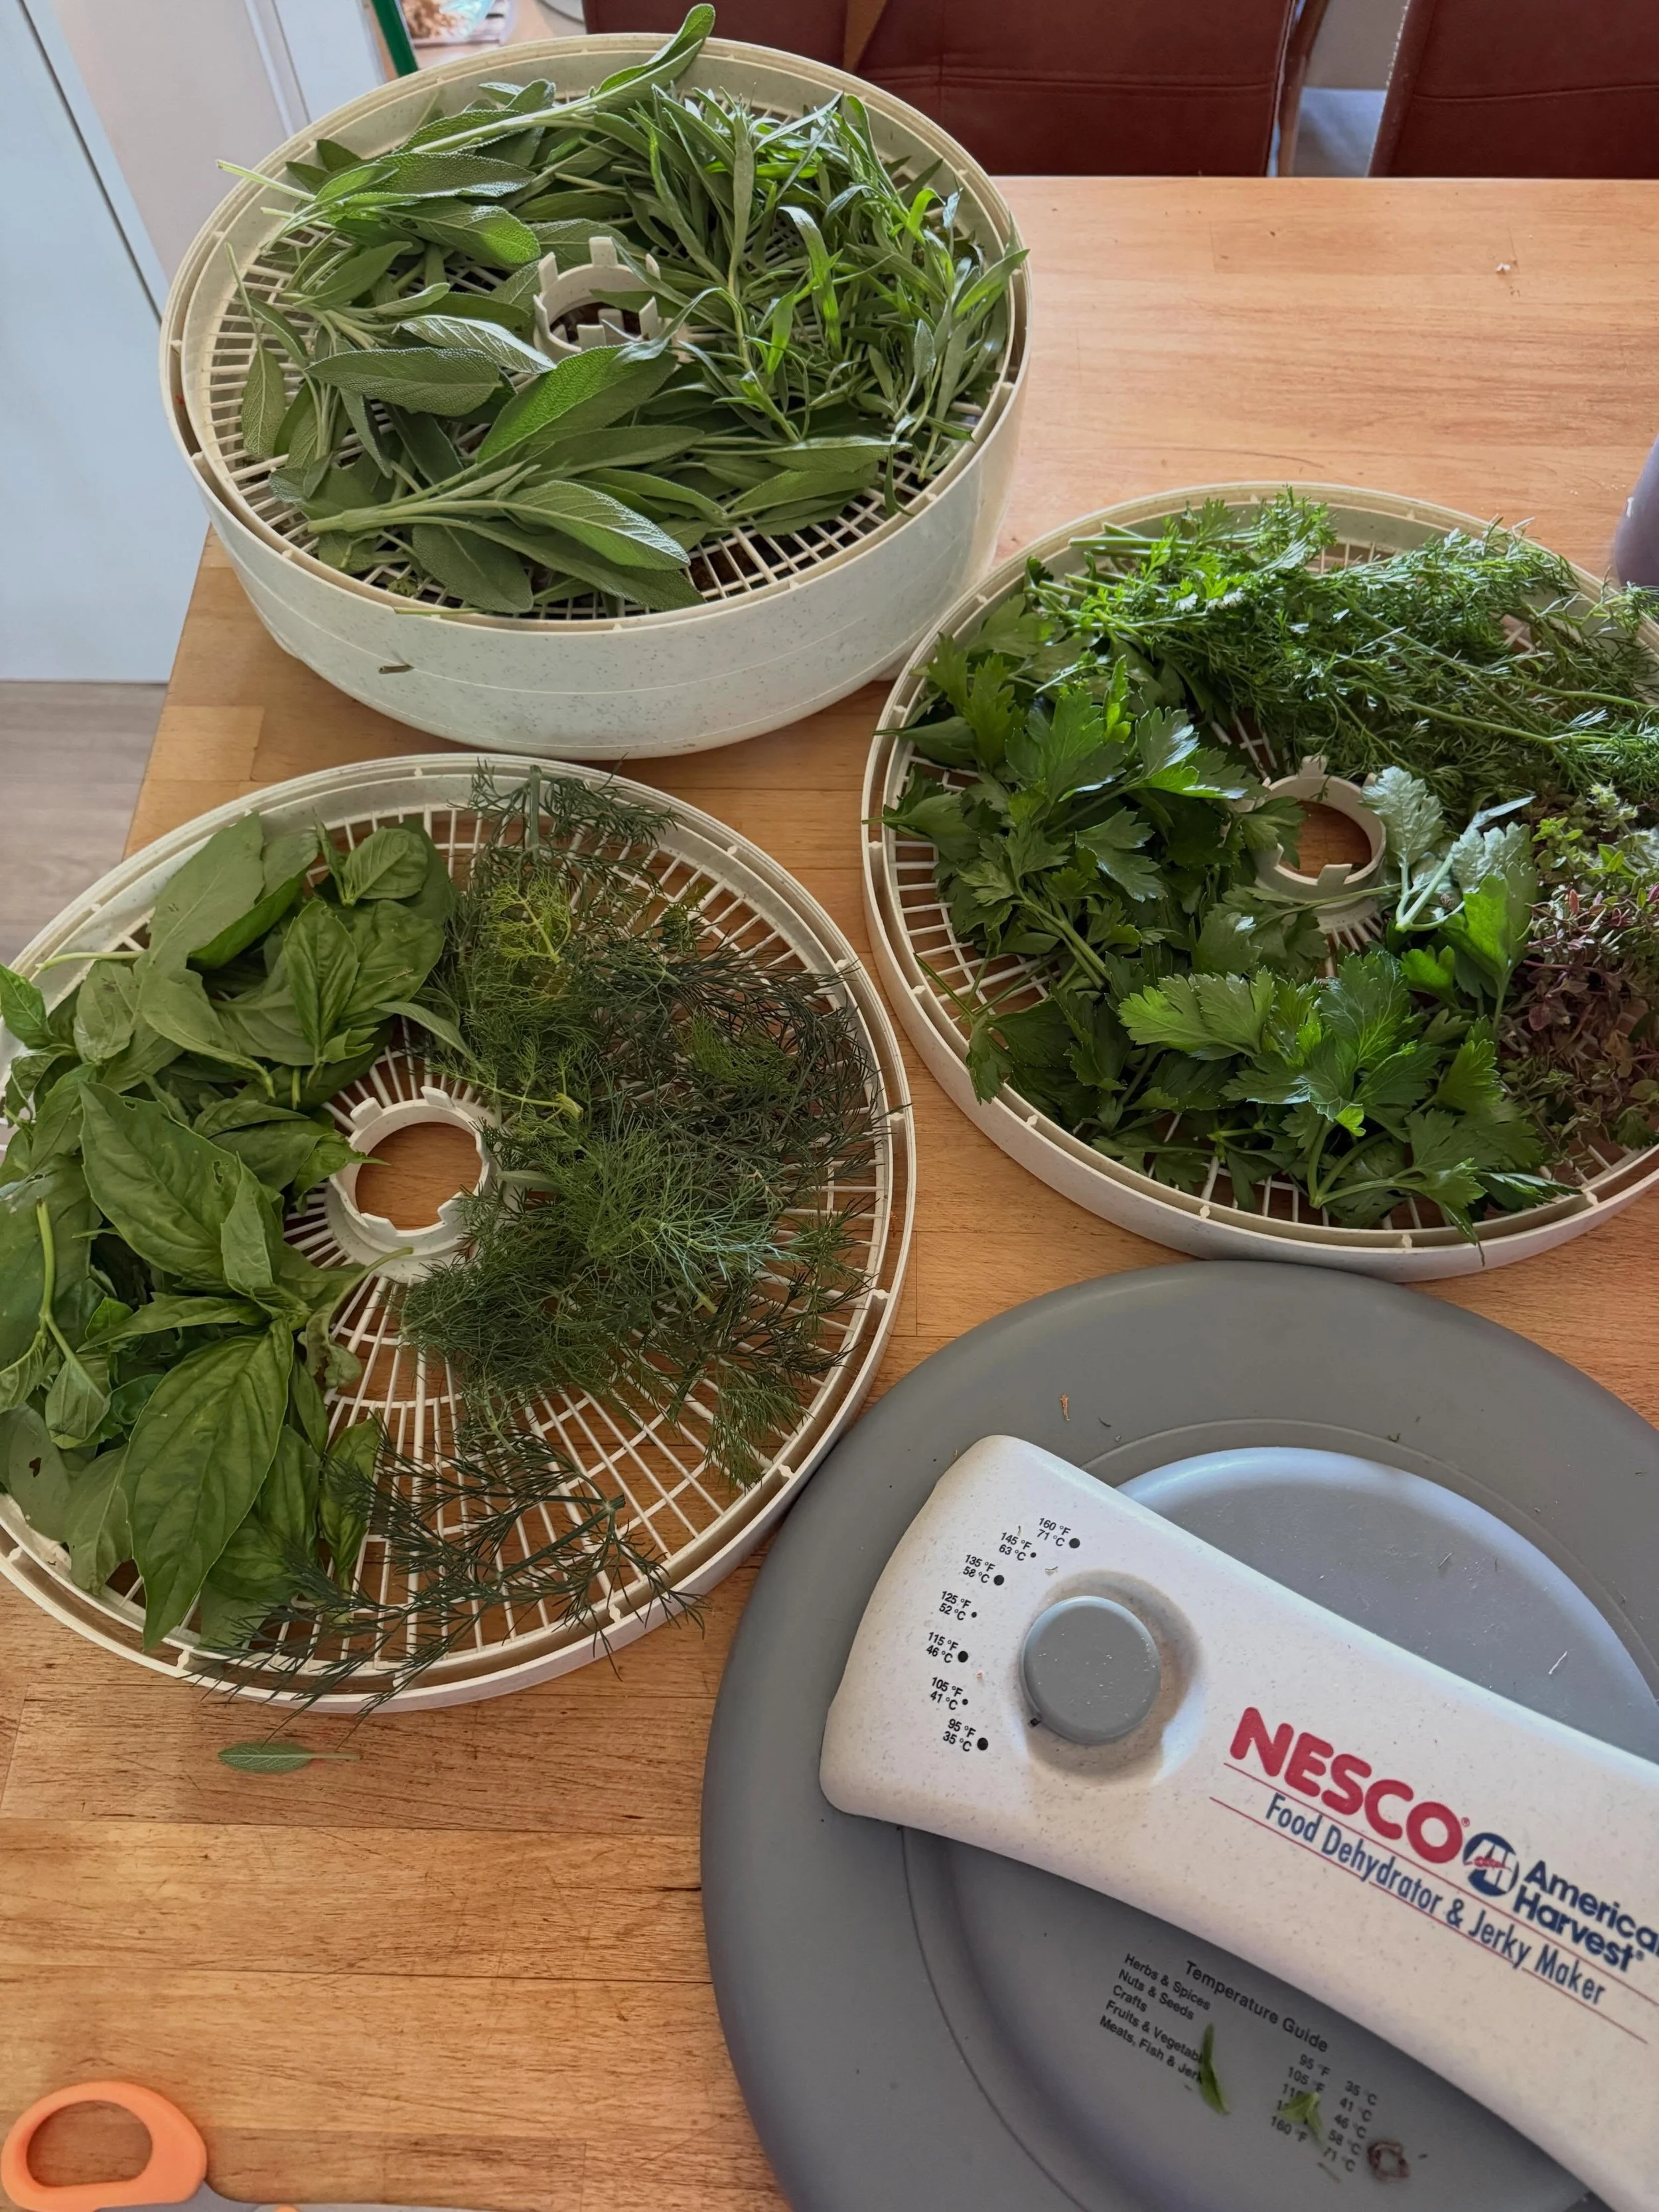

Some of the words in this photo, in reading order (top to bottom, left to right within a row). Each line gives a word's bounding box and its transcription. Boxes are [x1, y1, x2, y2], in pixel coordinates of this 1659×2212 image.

[1038, 1518, 1056, 1531] 160
[1059, 1525, 1071, 1536] °F
[1000, 1532, 1018, 1546] 145
[1021, 1539, 1033, 1550] °F
[1037, 1529, 1050, 1542] 71
[1053, 1534, 1065, 1547] °C
[999, 1544, 1012, 1556] 63
[1015, 1548, 1027, 1562] °C
[965, 1554, 982, 1568] 135
[984, 1562, 995, 1572] °F
[963, 1566, 975, 1578] 58
[978, 1572, 990, 1584] °C
[941, 1591, 958, 1605] 125
[960, 1598, 972, 1609] °F
[939, 1603, 952, 1616] 52
[954, 1608, 966, 1621] °C
[928, 1632, 946, 1646] 115
[947, 1639, 958, 1651] °F
[926, 1645, 940, 1659] 46
[941, 1651, 953, 1663] °C
[931, 1677, 950, 1692] 105
[951, 1686, 964, 1698] °F
[930, 1691, 944, 1705] 41
[946, 1697, 958, 1710] °C
[948, 1718, 962, 1732] 95
[964, 1726, 976, 1737] °F
[942, 1731, 957, 1744] 35
[959, 1737, 972, 1752] °C
[1265, 1793, 1324, 1842] Food
[1321, 1824, 1443, 1915] Dehydrator
[1446, 1898, 1465, 1927] &
[1468, 1911, 1532, 1970] Jerky
[1534, 1943, 1606, 2005] Maker
[1524, 1860, 1659, 1958] America
[1185, 1960, 1279, 2026] Temperature
[1282, 2018, 1329, 2053] Guide
[1124, 1953, 1159, 1981] Herbs
[1160, 1974, 1169, 1986] &
[1173, 1980, 1211, 2011] Spices
[1299, 2054, 1315, 2070] 95
[1345, 2080, 1361, 2097] 35
[1118, 1968, 1145, 1992] Nuts
[1147, 1986, 1156, 1998] &
[1159, 1992, 1194, 2021] Seeds
[1287, 2066, 1309, 2085] 105
[1339, 2097, 1354, 2112] 41
[1113, 1984, 1148, 2013] Crafts
[1334, 2114, 1349, 2130] 46
[1106, 1999, 1141, 2028] Fruits
[1141, 2021, 1150, 2033] &
[1328, 2129, 1344, 2146] 58
[1100, 2015, 1136, 2046] Meats,
[1139, 2038, 1165, 2061] Fish
[1166, 2055, 1175, 2067] &
[1271, 2115, 1292, 2136] 160
[1323, 2146, 1337, 2162] 71
